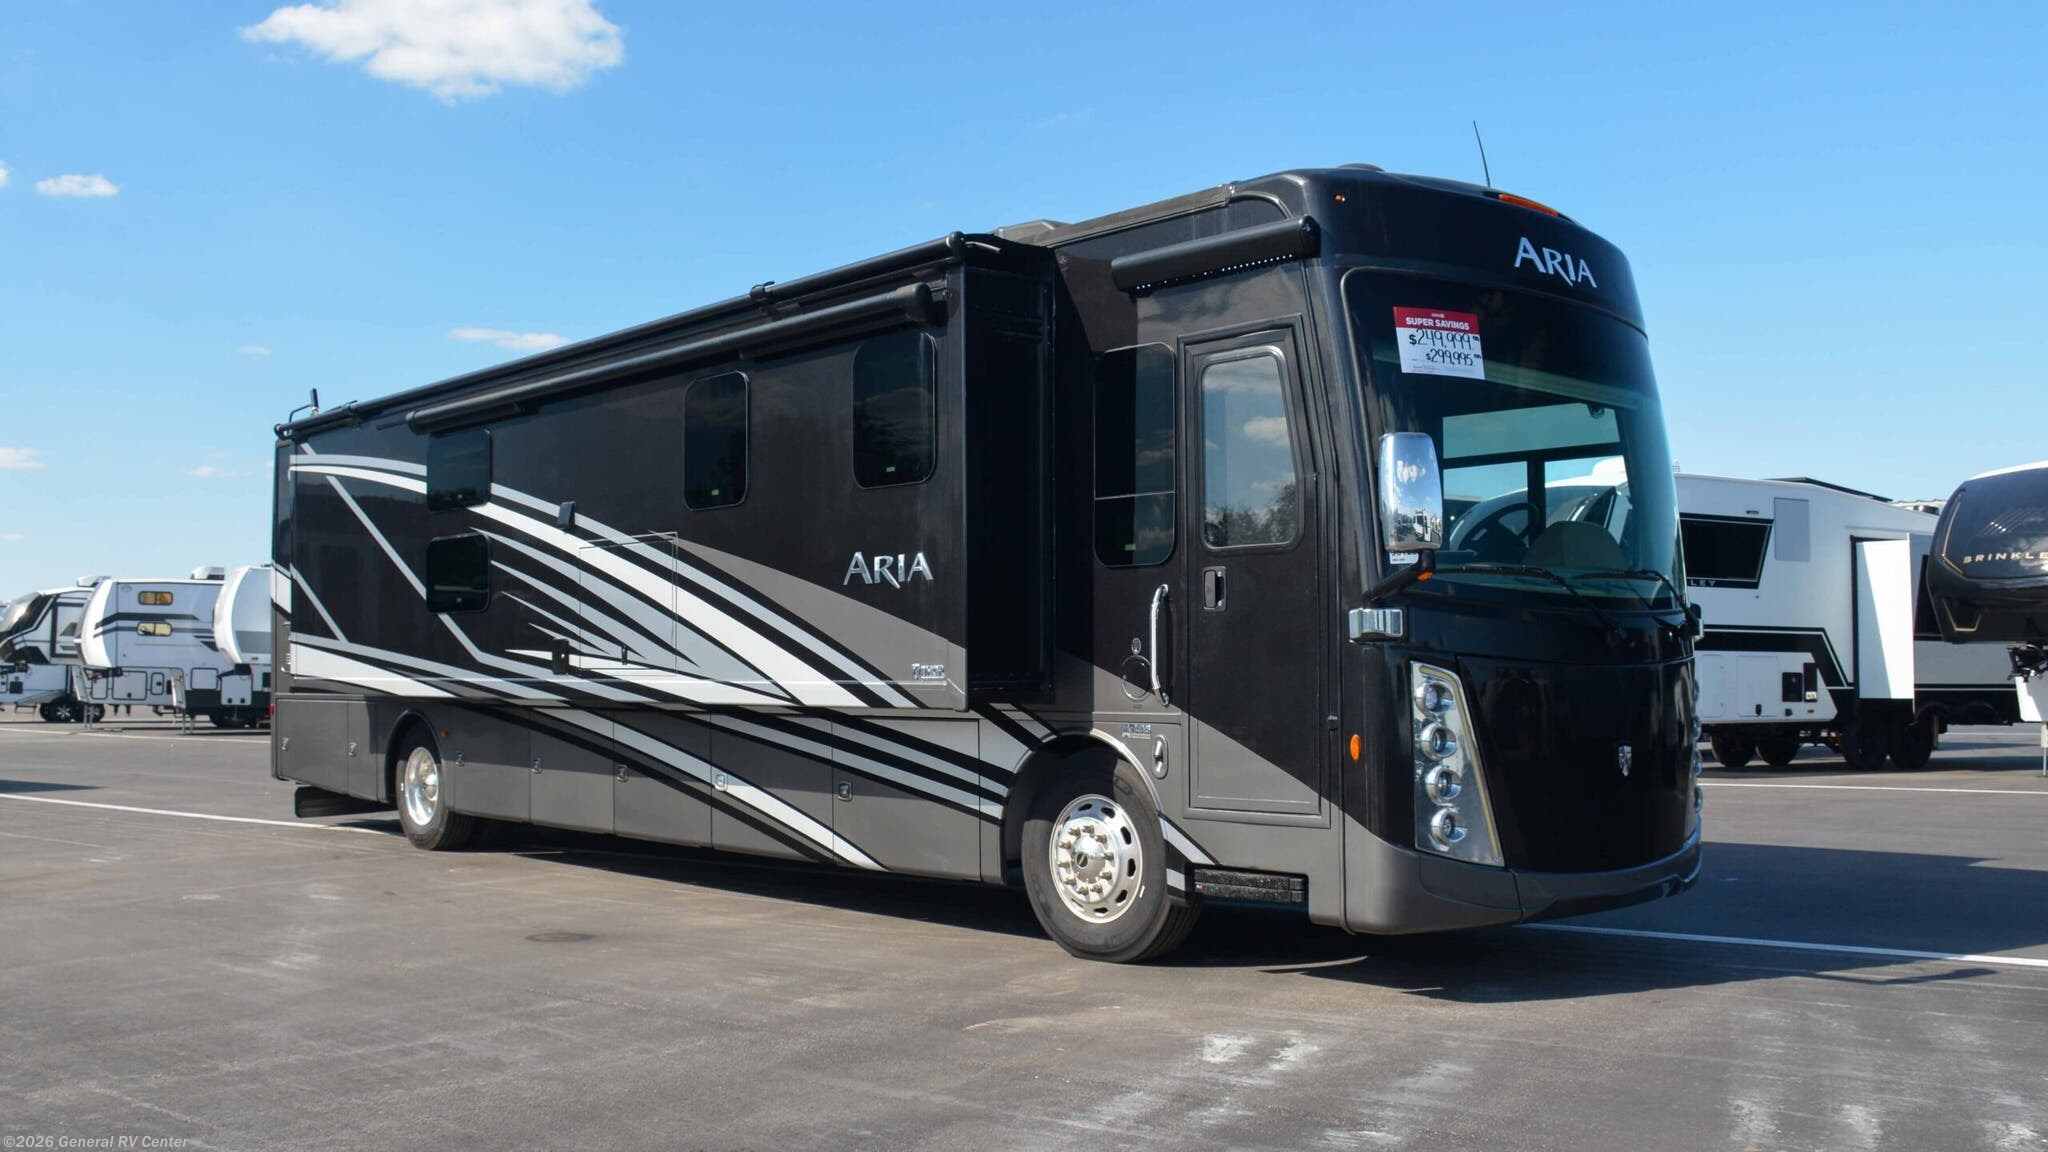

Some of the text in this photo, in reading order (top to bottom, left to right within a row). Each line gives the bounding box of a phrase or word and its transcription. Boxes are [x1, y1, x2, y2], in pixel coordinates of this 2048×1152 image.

[1513, 236, 1598, 288] ARIA
[1405, 317, 1470, 331] SUPER SAVINGS
[842, 551, 934, 590] ARIA
